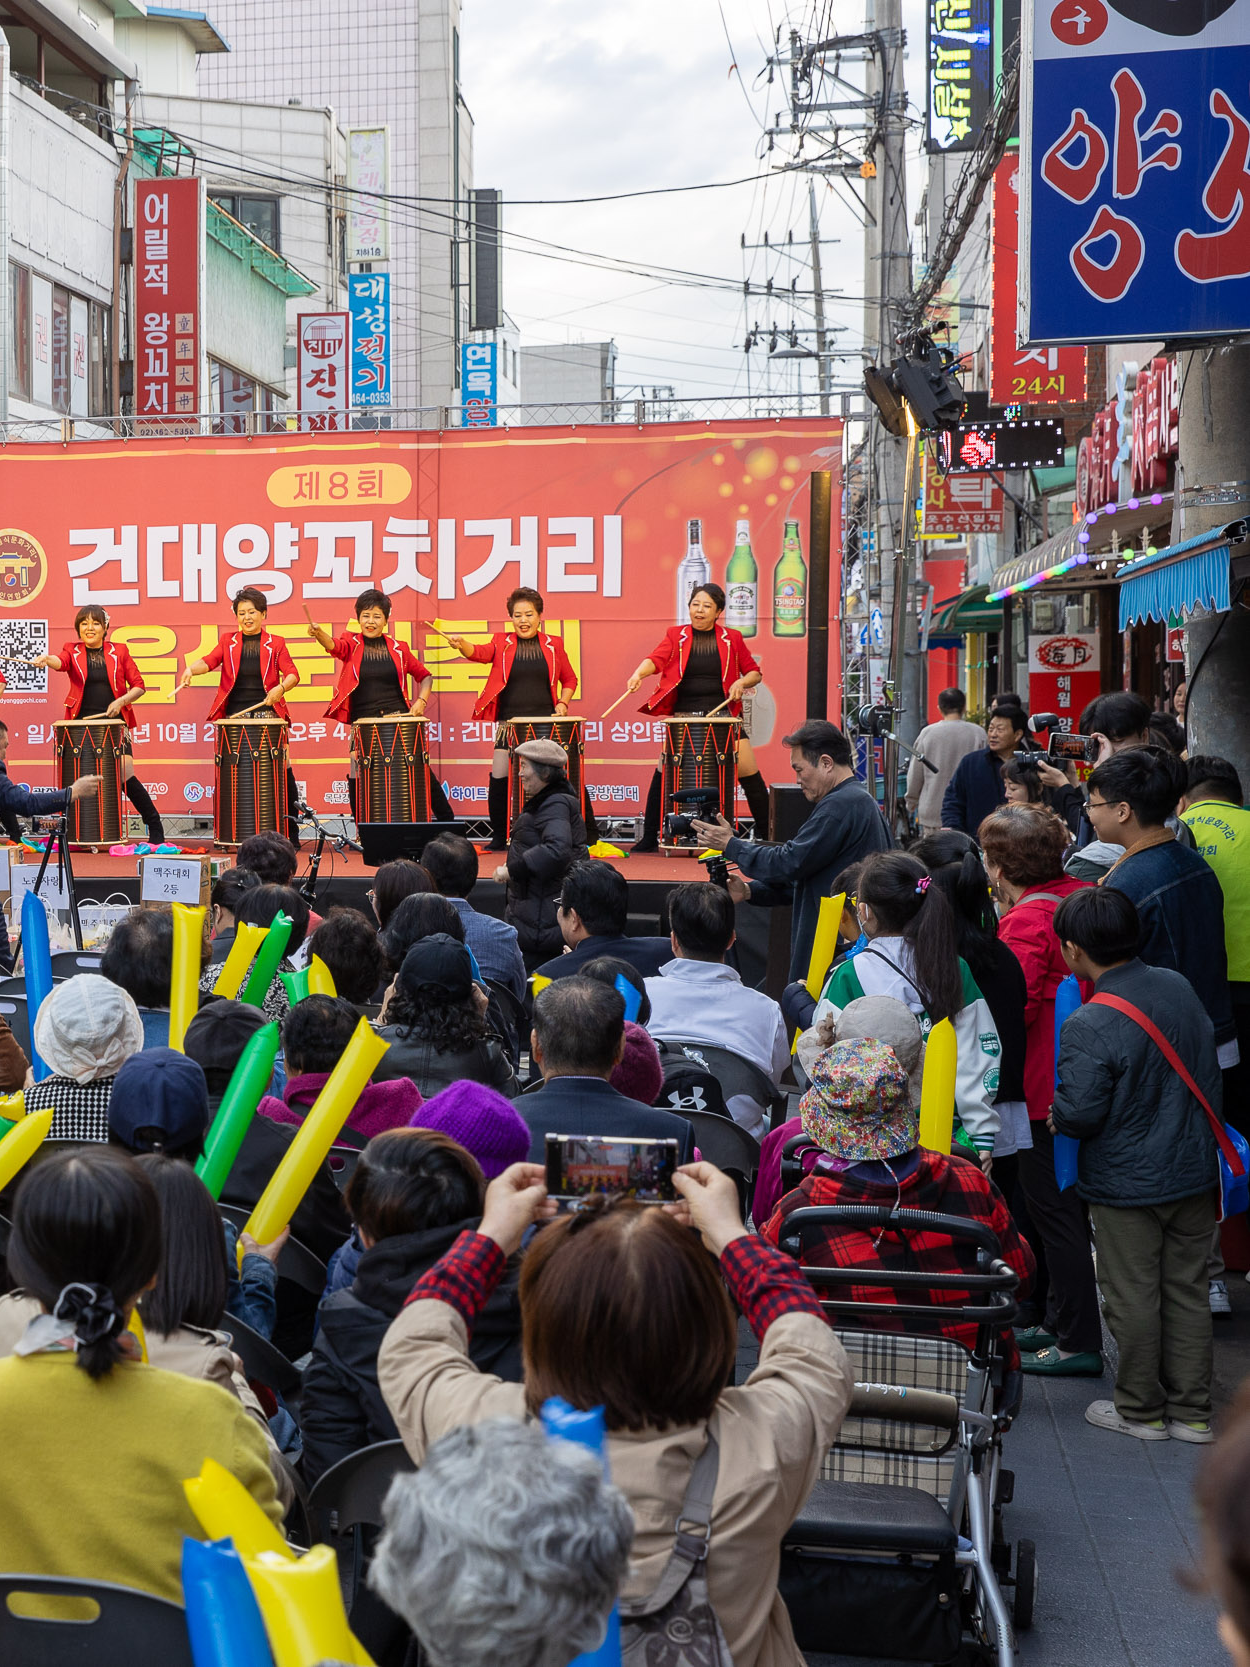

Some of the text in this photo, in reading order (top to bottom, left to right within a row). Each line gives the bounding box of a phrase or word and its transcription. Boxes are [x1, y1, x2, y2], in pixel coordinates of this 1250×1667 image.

[144, 193, 170, 413] 어릴적 왕꼬치
[353, 276, 386, 392] 대성전기
[1011, 374, 1066, 396] 24시
[293, 467, 384, 499] 제8회
[157, 723, 197, 743] 10월
[289, 722, 327, 742] 오후
[153, 867, 190, 879] 맥주대회
[163, 884, 179, 895] 2등
